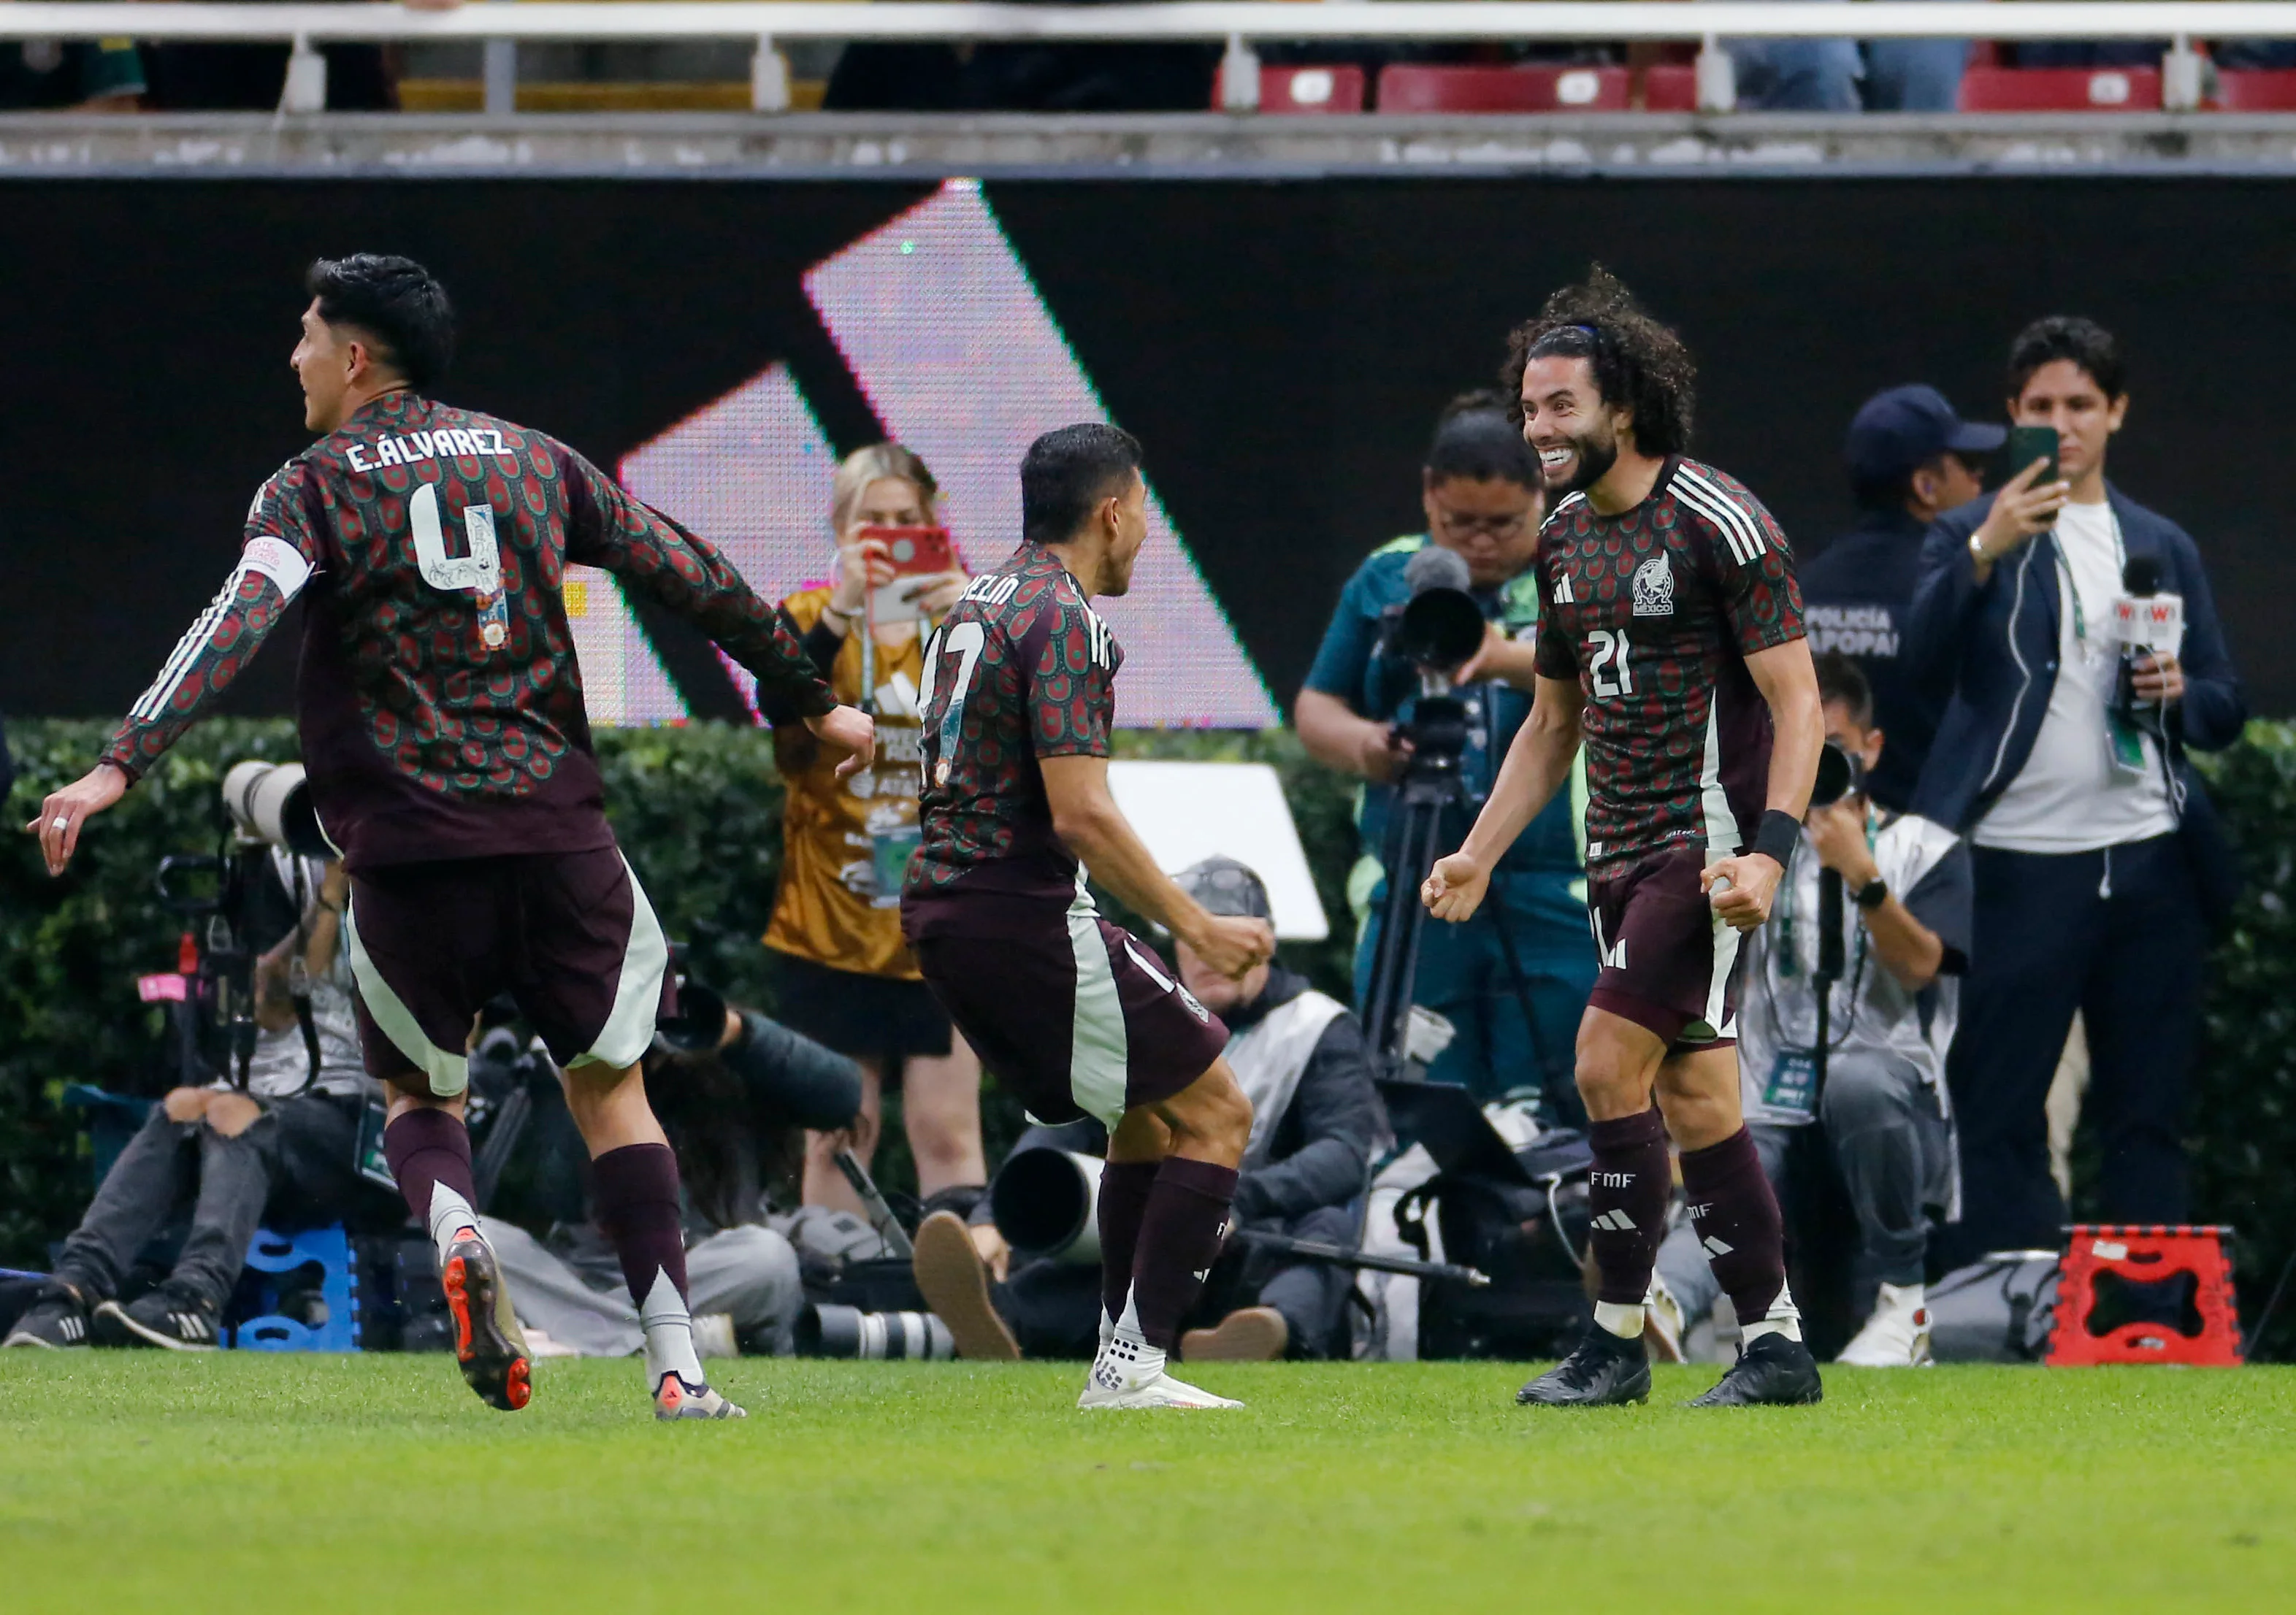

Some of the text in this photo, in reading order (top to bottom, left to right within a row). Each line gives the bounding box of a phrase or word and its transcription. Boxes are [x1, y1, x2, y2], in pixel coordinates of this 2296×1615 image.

[345, 429, 513, 473] E.ÁLVAREZ
[409, 483, 511, 651] 4
[1588, 629, 1633, 698] 21
[1591, 1171, 1637, 1189] FMF
